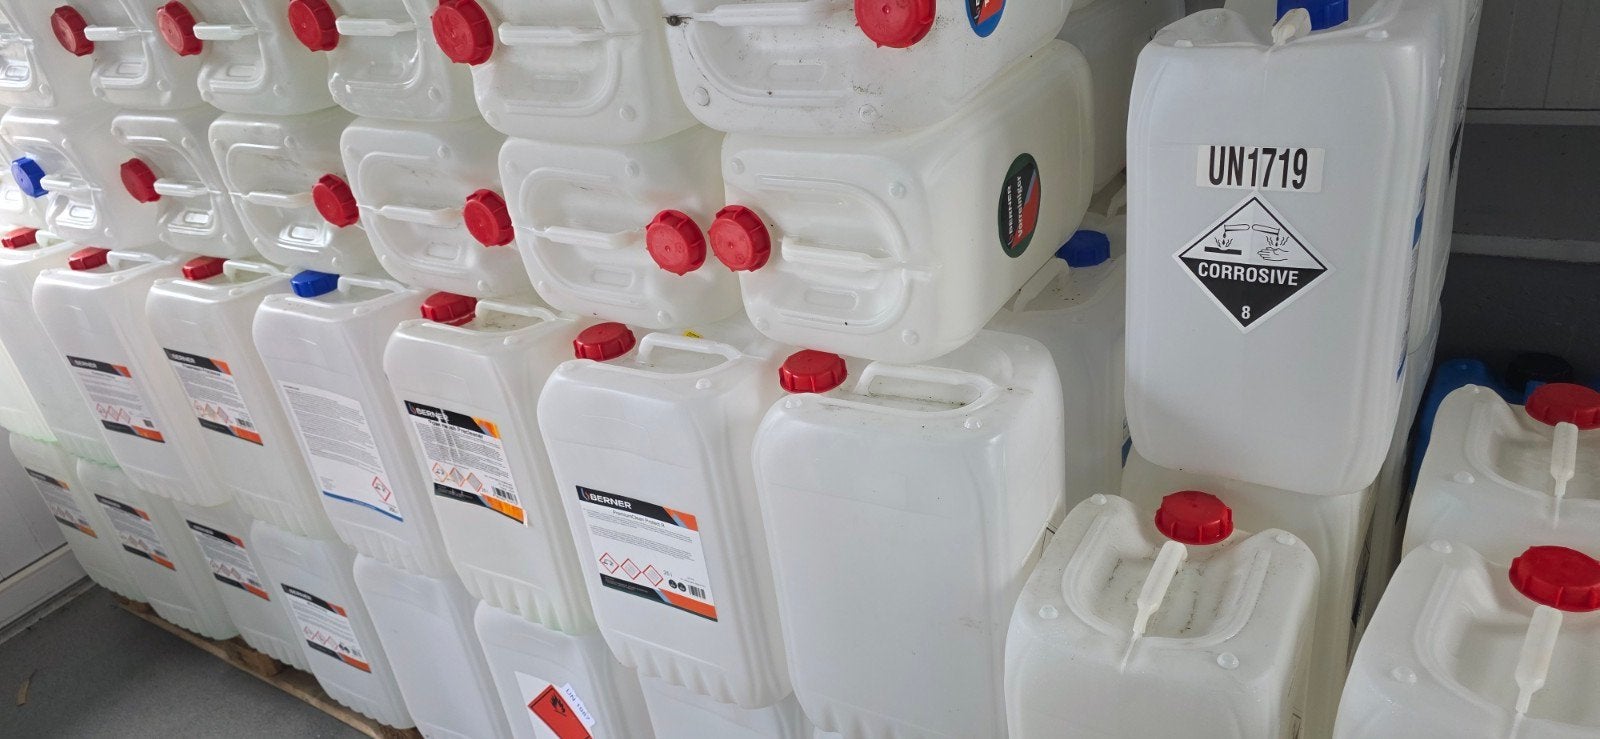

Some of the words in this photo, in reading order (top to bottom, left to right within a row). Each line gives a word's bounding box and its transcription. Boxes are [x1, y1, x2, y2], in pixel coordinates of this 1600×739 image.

[1208, 145, 1308, 190] UN1719
[1198, 262, 1299, 286] CORROSIVE
[1241, 305, 1251, 320] 8
[590, 493, 632, 510] BERNER
